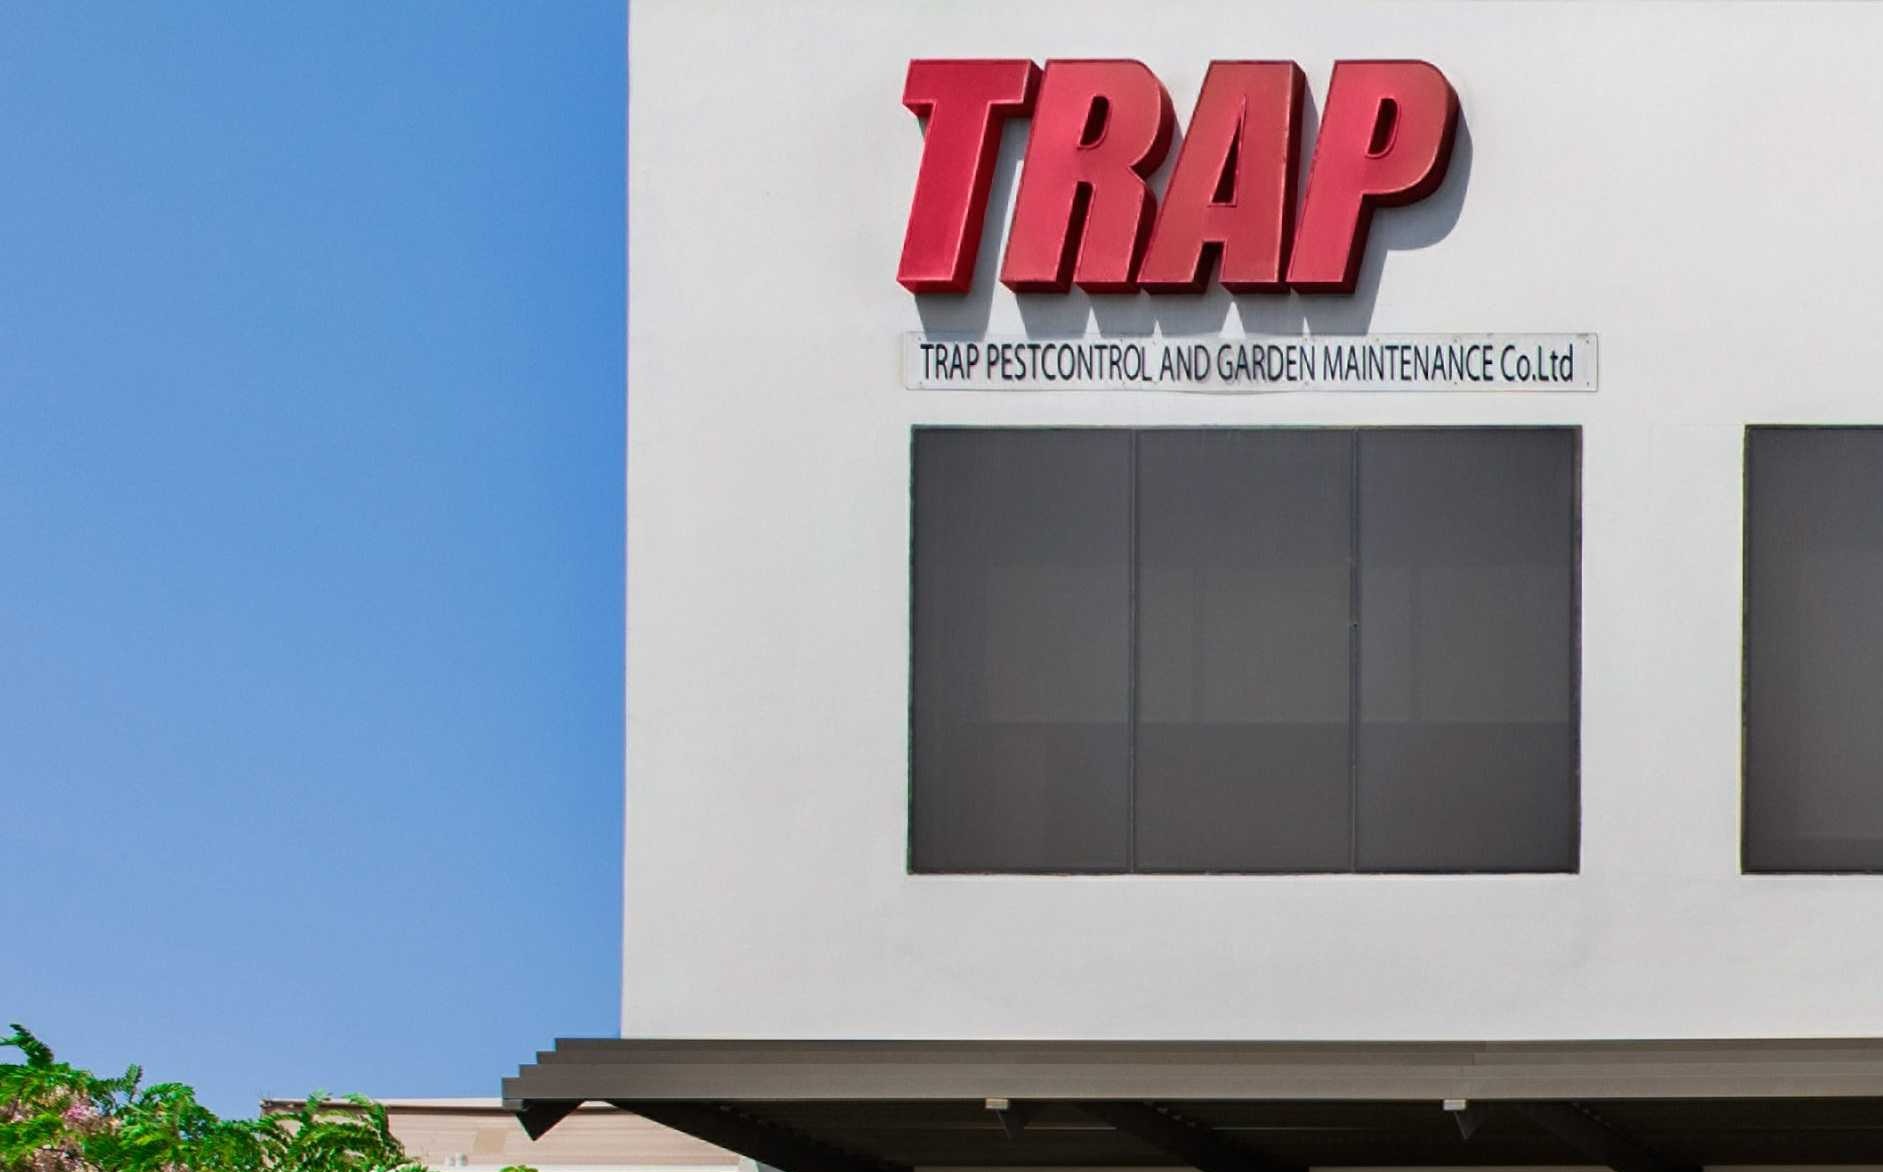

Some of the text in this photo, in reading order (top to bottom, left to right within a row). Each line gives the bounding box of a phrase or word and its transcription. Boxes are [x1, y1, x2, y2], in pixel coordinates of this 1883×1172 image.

[897, 59, 1459, 294] TRAP
[920, 343, 1574, 382] TRAP PESTCONTROL AND GARDEN MAINTENANCE Co.Ltd
